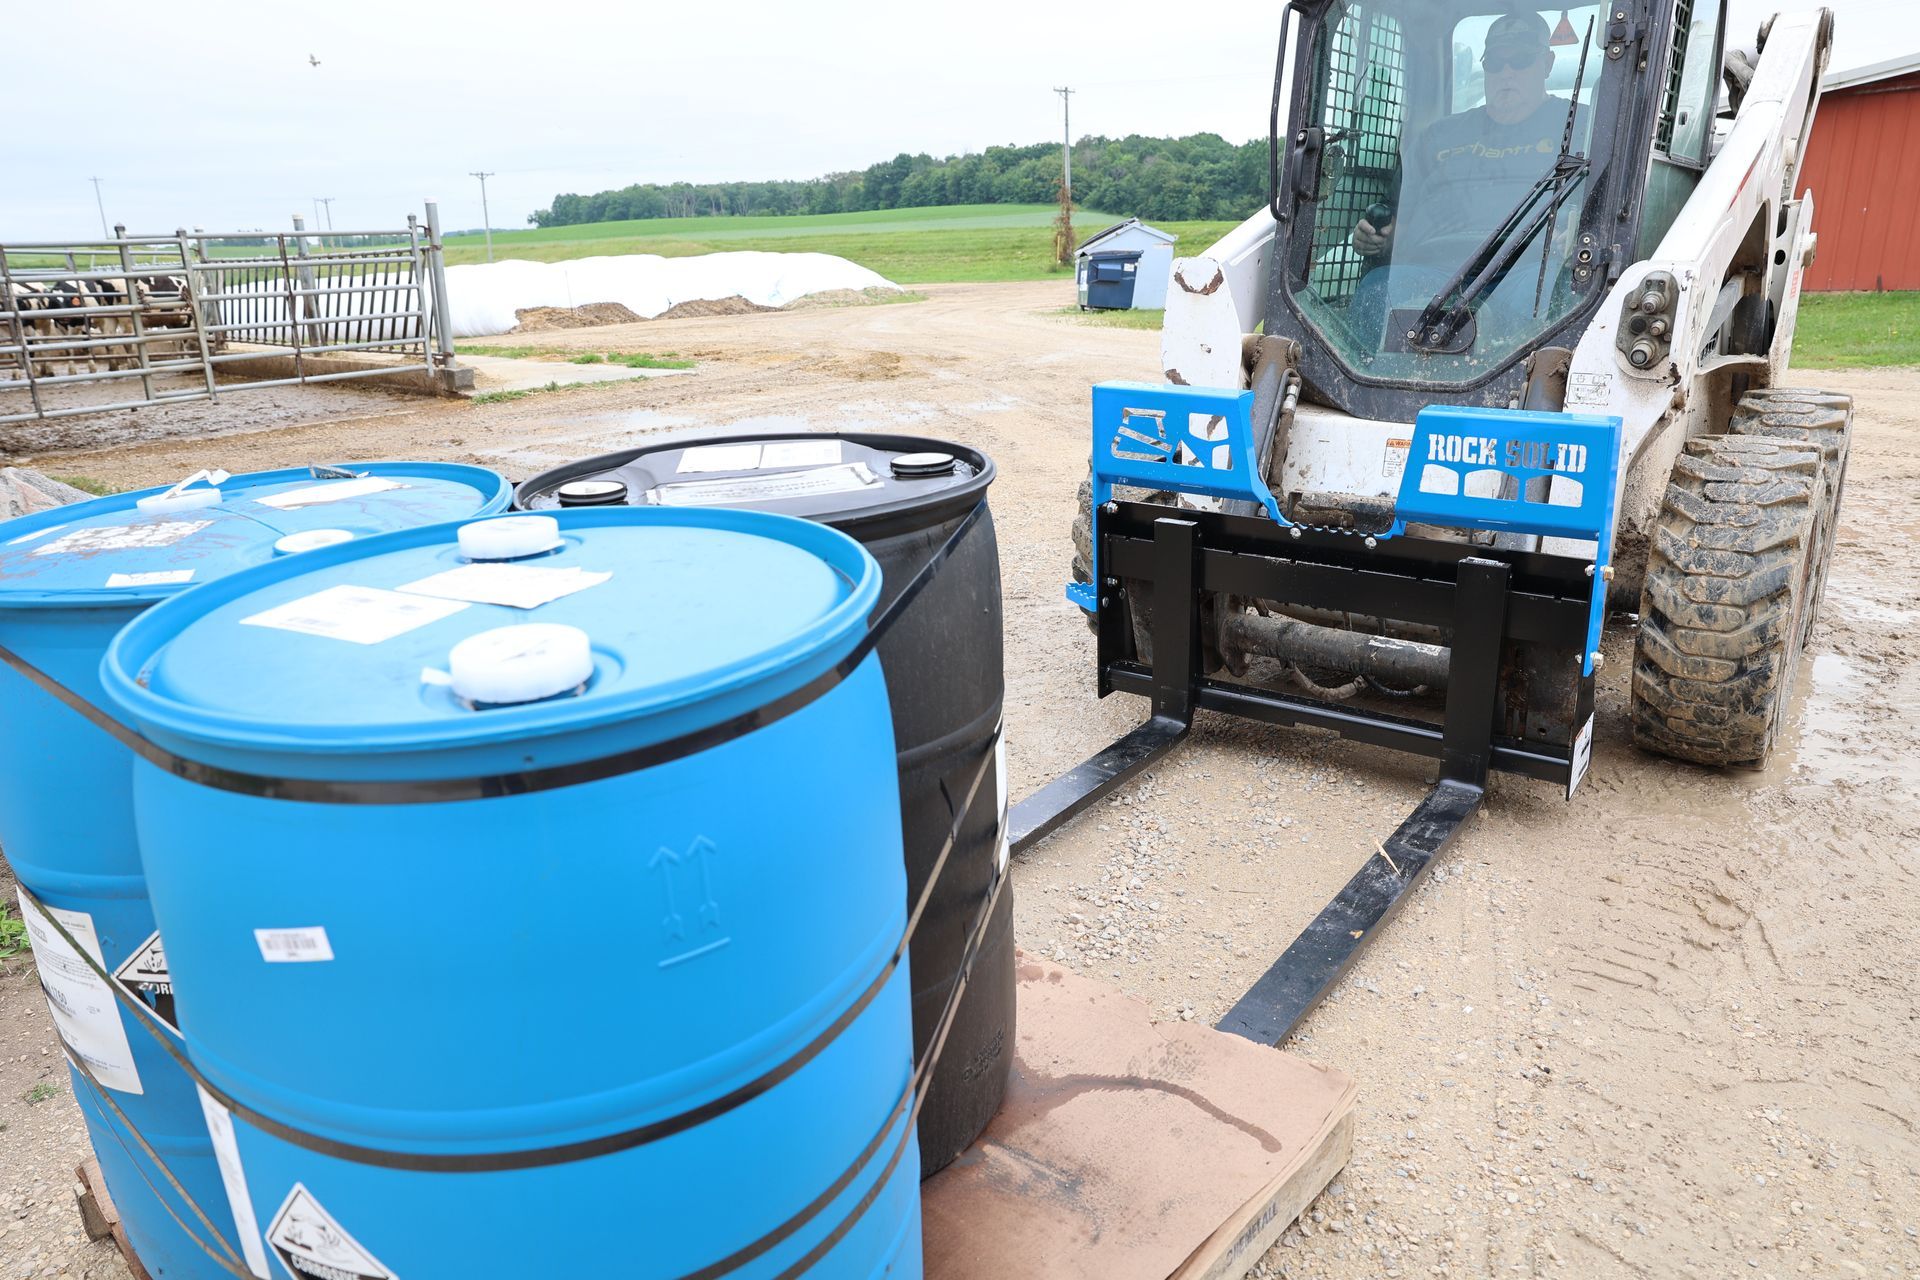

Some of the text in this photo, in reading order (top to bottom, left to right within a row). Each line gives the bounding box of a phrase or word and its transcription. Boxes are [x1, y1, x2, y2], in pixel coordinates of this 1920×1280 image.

[1437, 141, 1533, 161] carhartt
[1427, 433, 1498, 466] ROCK
[1505, 439, 1588, 473] SOLID
